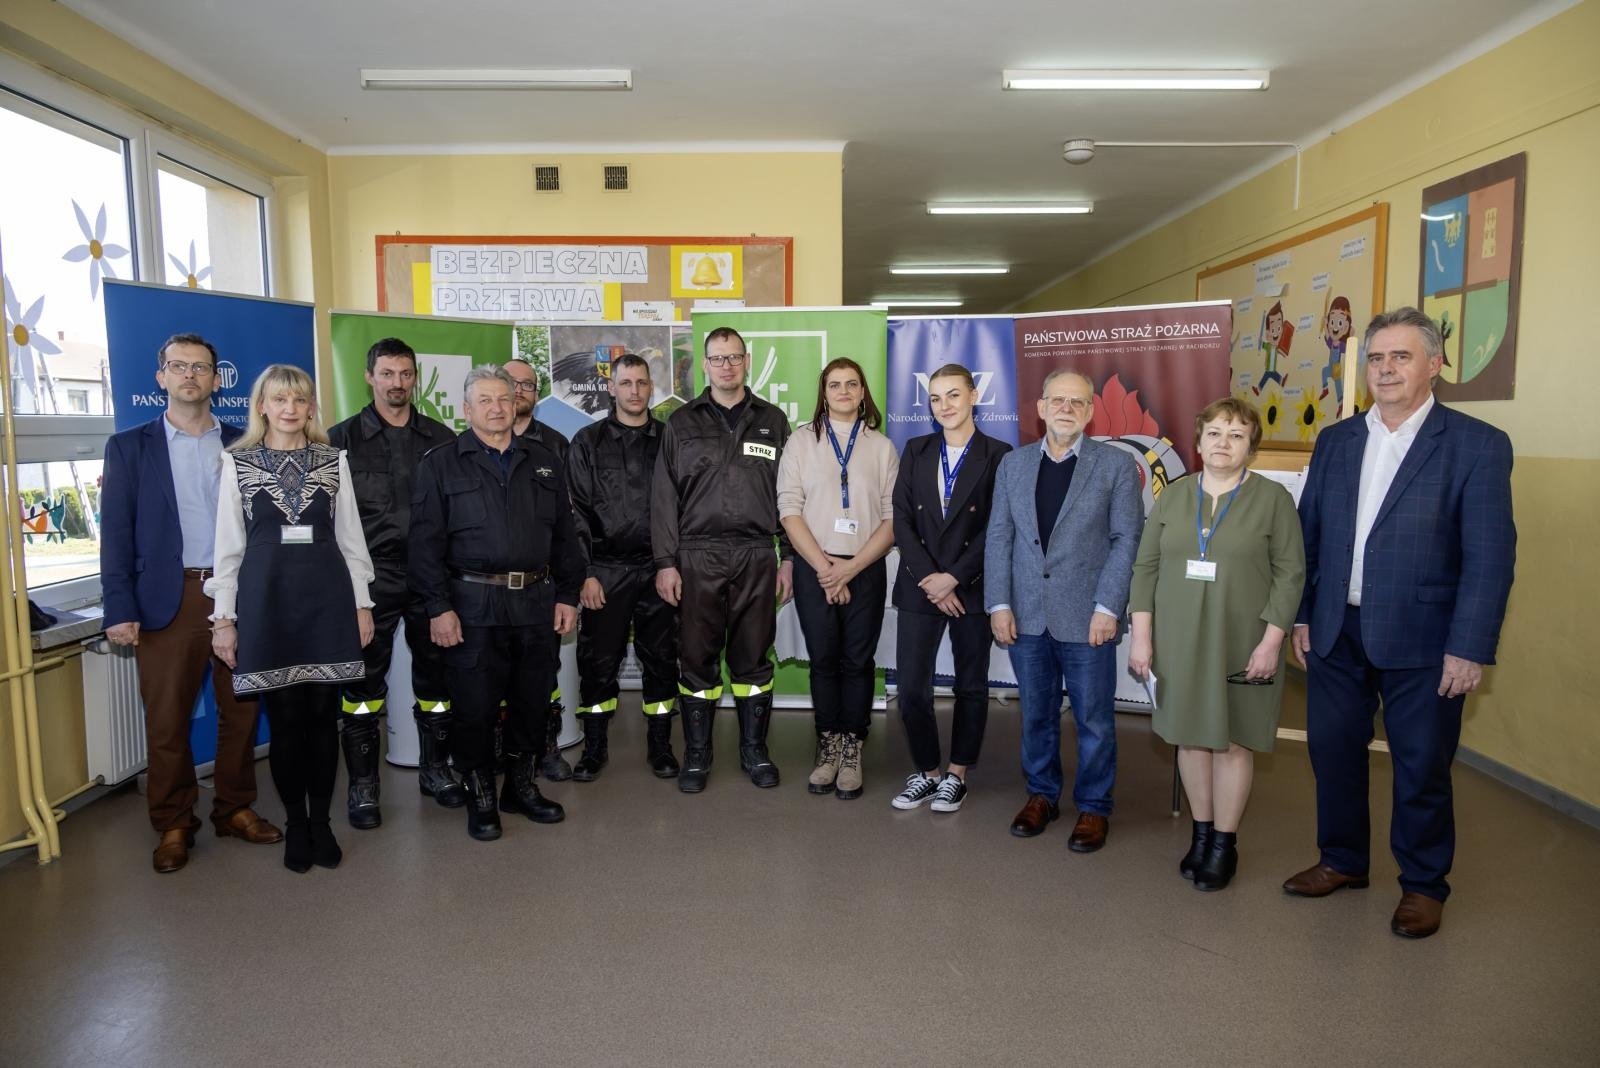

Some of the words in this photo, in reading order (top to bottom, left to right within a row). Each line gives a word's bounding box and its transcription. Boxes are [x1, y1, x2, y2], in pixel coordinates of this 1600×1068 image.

[437, 251, 647, 275] BEZPIECZNA
[437, 288, 602, 312] PRZERWA
[1024, 329, 1107, 344] PAŃSTWOWA
[1111, 324, 1152, 339] STRAŻ
[1155, 322, 1220, 337] POŻARNA
[1024, 350, 1051, 358] KOMENDA
[1052, 349, 1086, 357] POWIATOWA
[572, 383, 597, 392] GMINA
[912, 371, 997, 407] NZ
[218, 396, 251, 408] INSPE
[888, 411, 935, 425] Narodowy
